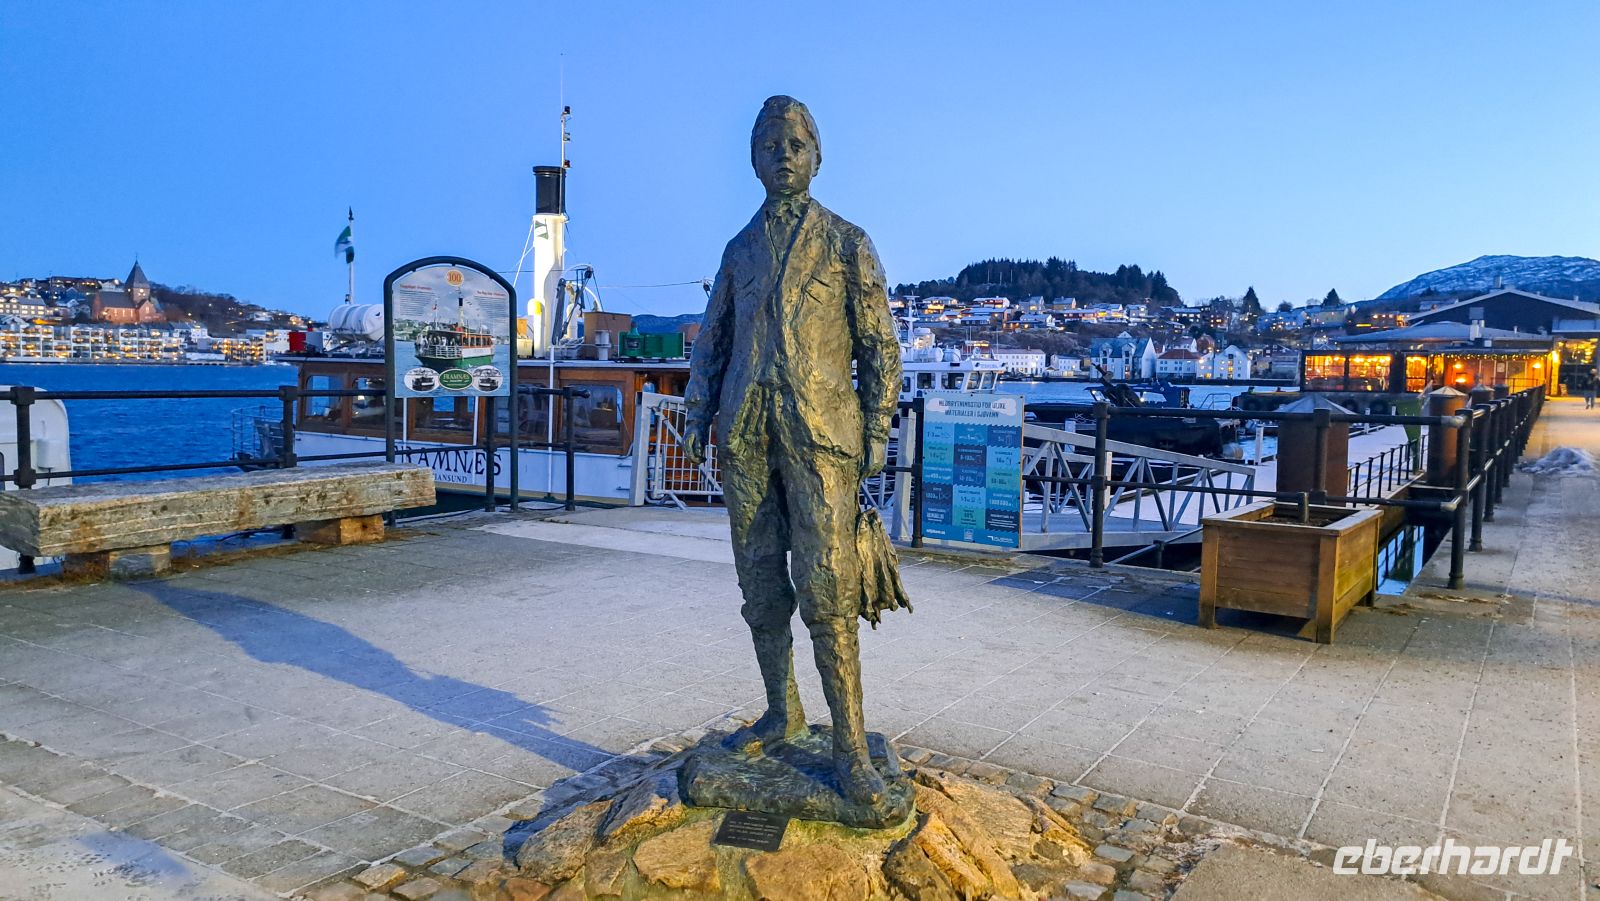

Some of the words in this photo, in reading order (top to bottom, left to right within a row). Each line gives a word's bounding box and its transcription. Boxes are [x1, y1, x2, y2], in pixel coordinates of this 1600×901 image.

[447, 273, 461, 282] 100
[982, 401, 991, 409] FOR
[394, 445, 502, 476] RAMNÆS
